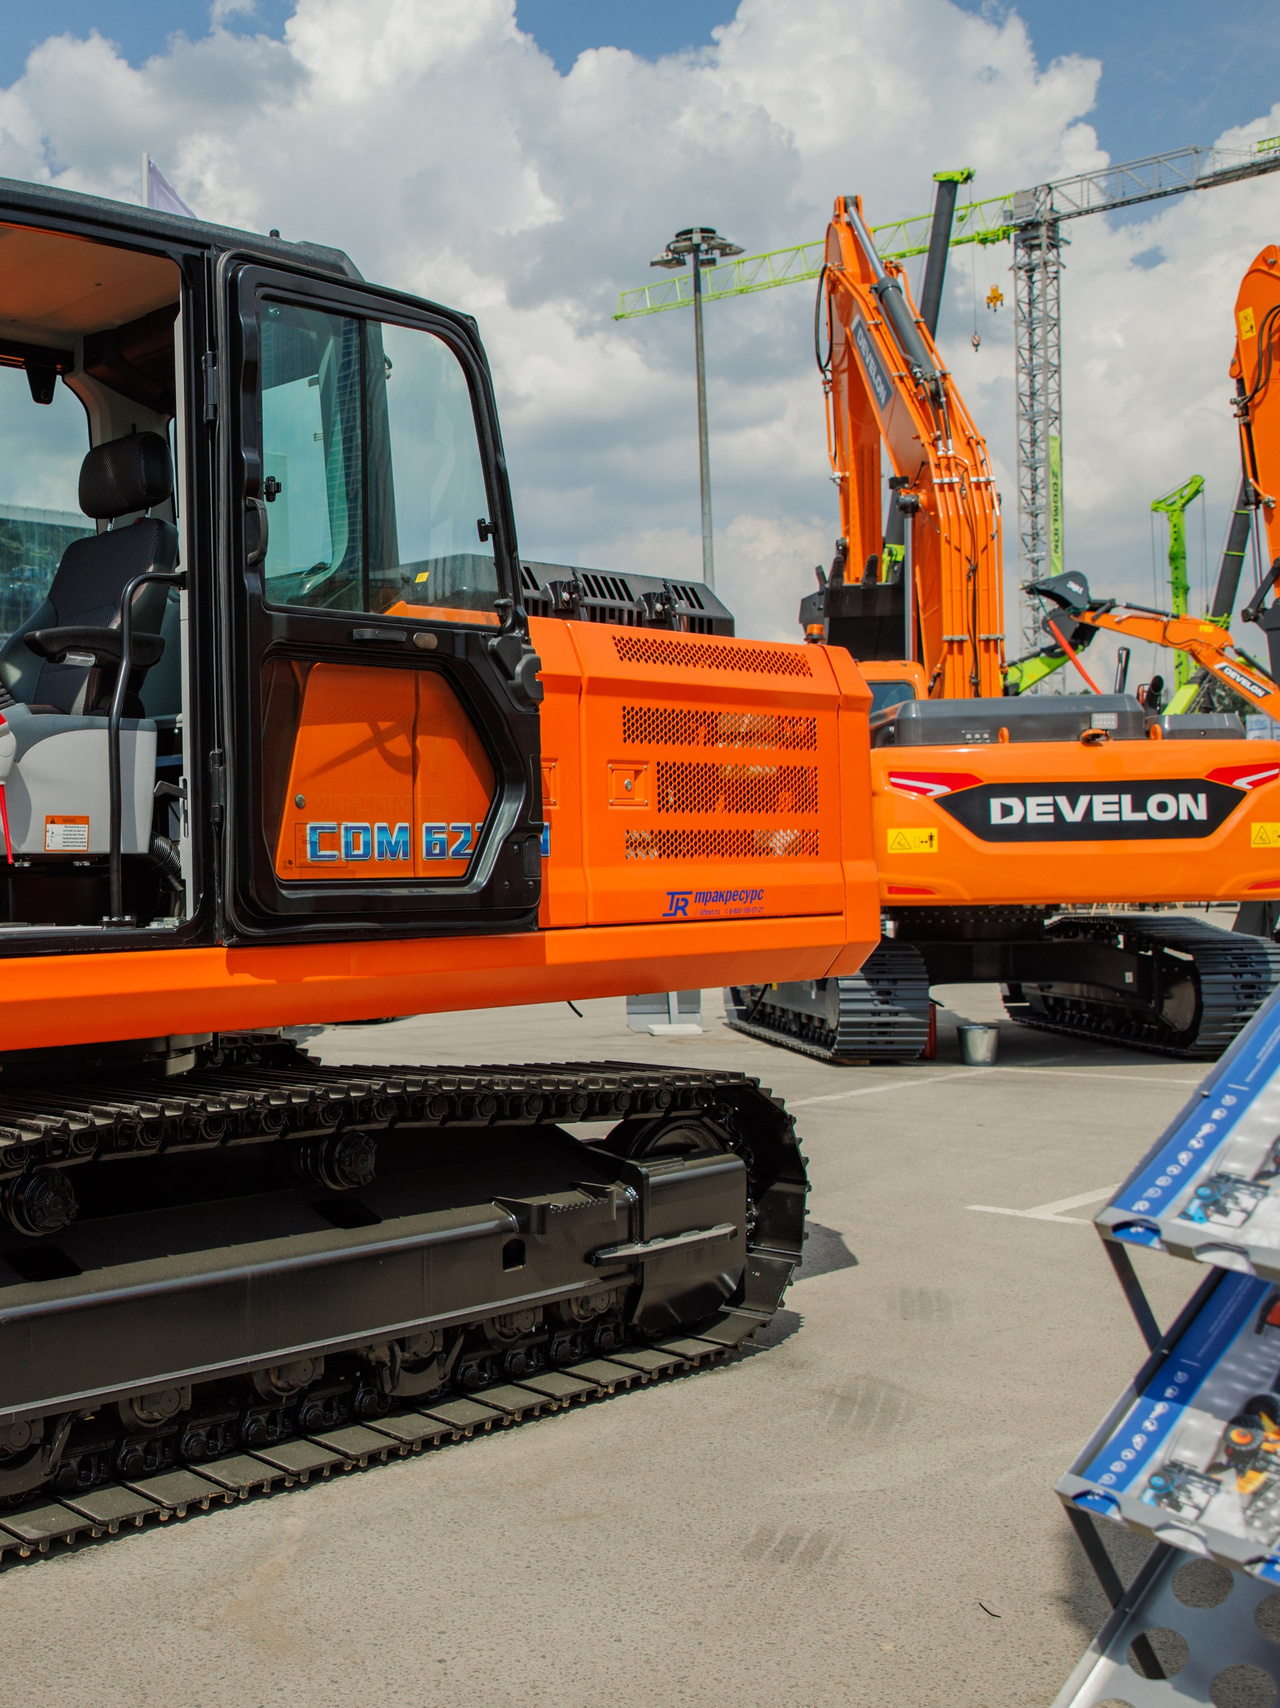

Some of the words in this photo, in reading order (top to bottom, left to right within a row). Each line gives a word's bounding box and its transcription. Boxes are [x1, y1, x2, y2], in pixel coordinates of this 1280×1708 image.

[856, 327, 887, 405] DEVELON
[1052, 470, 1060, 555] ZOOMLION
[1223, 666, 1265, 698] DEVELON
[989, 792, 1208, 825] DEVELON
[306, 822, 411, 862] CDM
[694, 888, 764, 906] тракресурс
